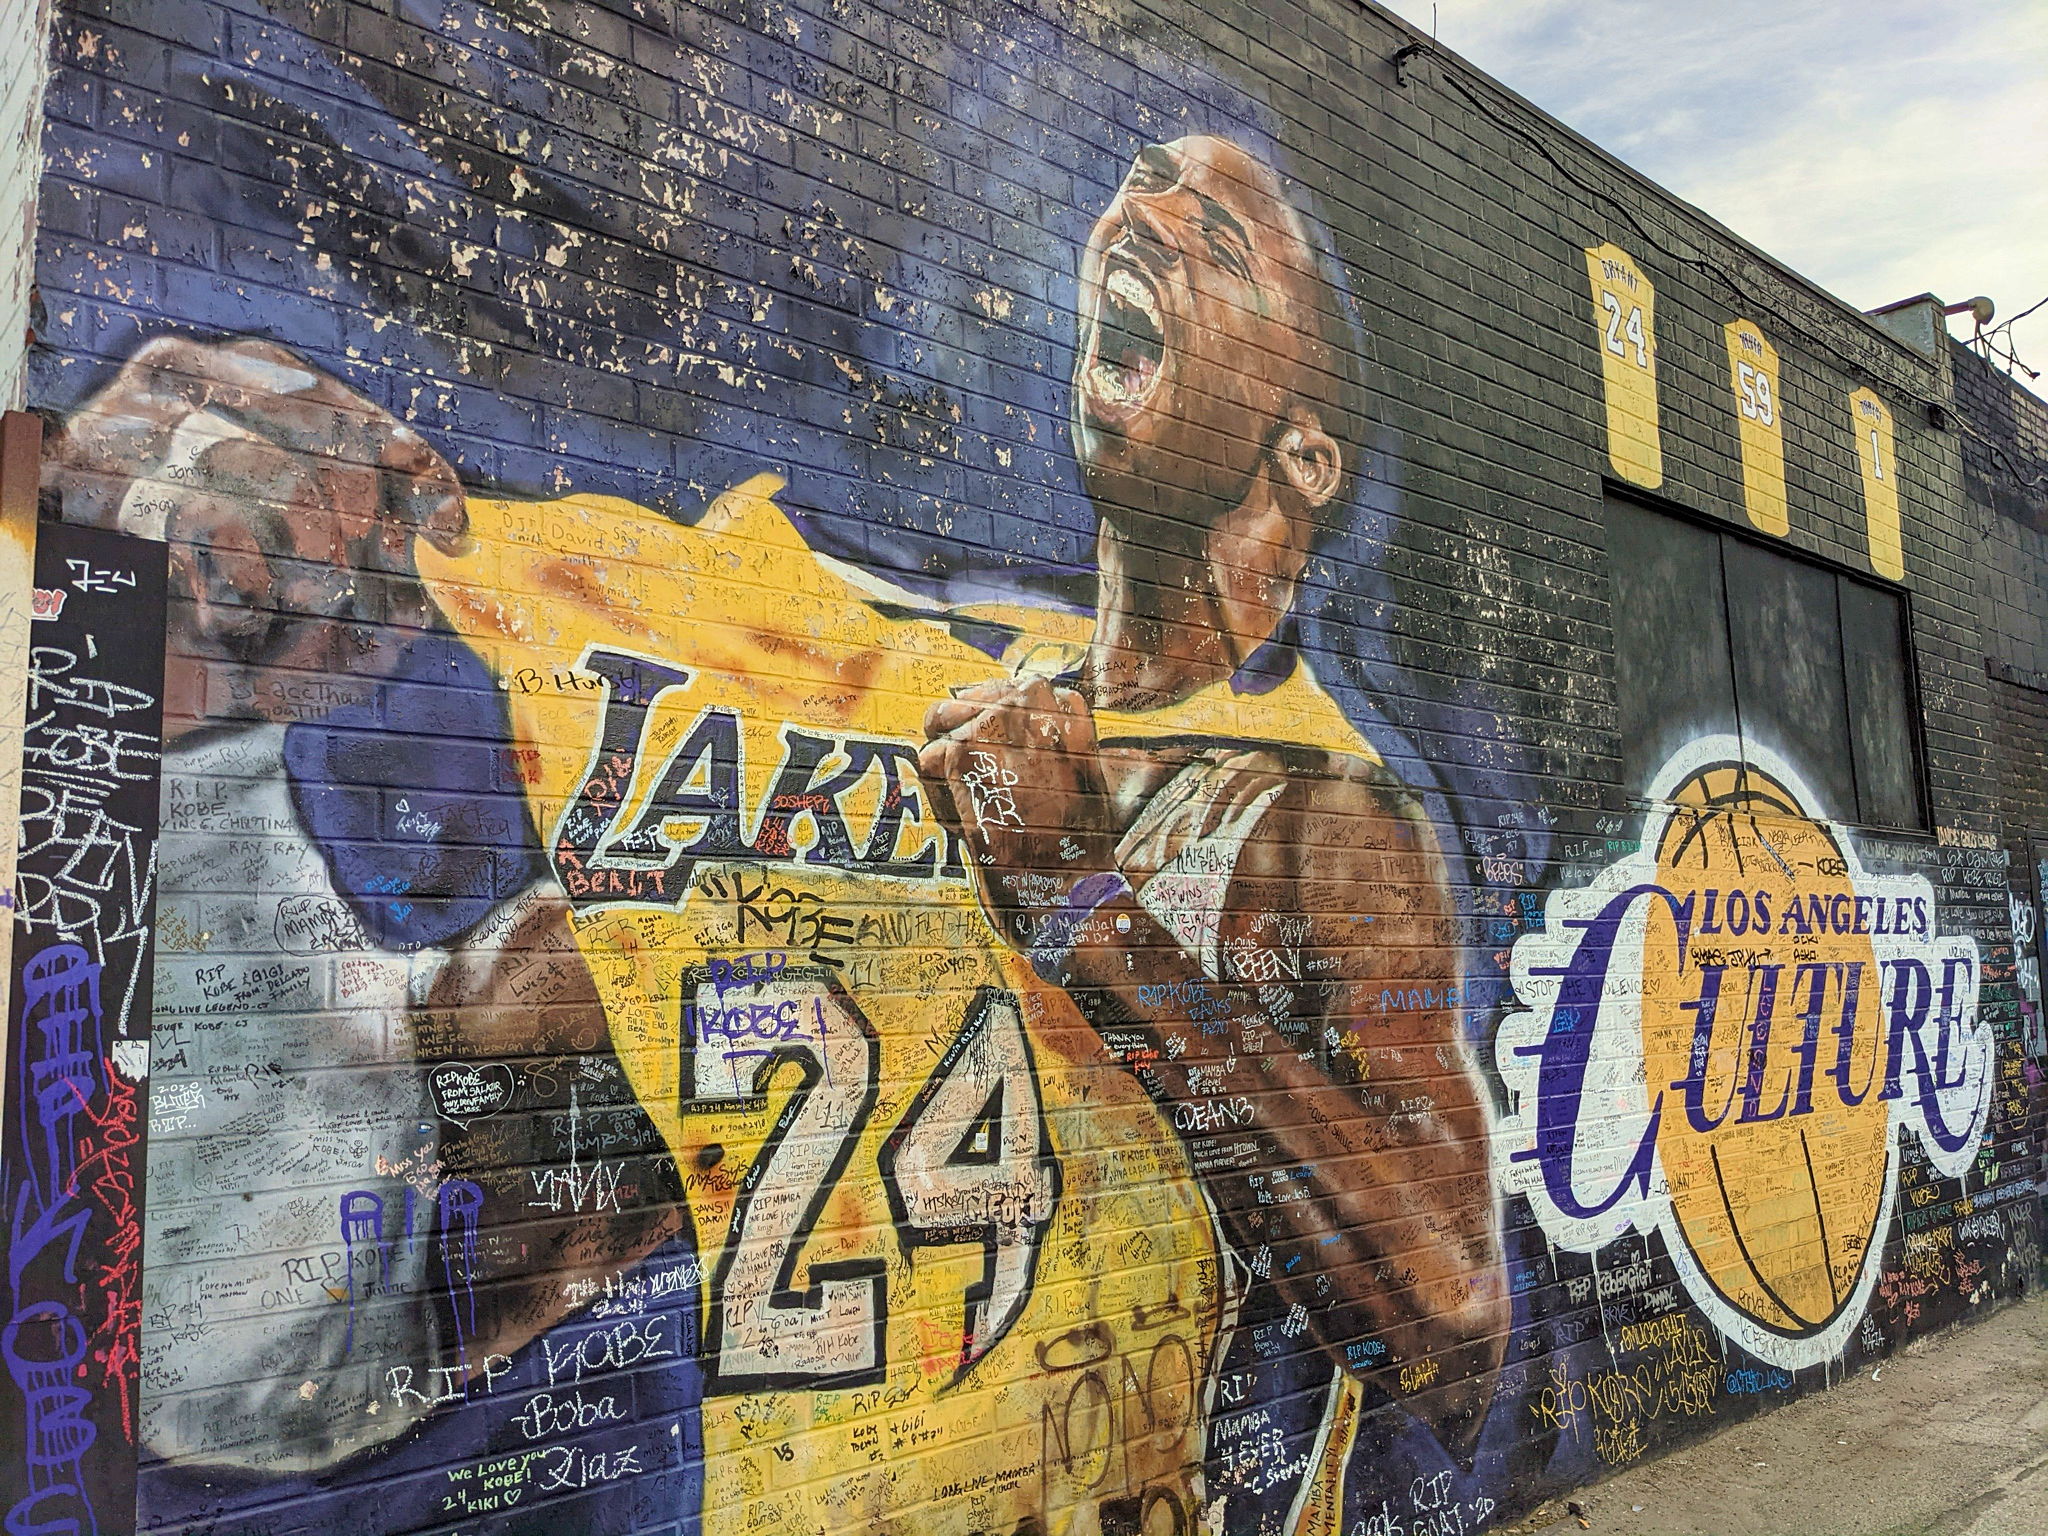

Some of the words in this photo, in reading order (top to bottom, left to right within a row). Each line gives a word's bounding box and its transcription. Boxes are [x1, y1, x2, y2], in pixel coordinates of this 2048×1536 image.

[1600, 258, 1638, 293] BRYANT
[1603, 290, 1648, 369] 24
[1737, 360, 1774, 427] 59
[1870, 430, 1884, 480] 1
[1700, 888, 1772, 937] LOS
[1779, 892, 1928, 937] ANGELES
[195, 964, 227, 986] RIP
[203, 978, 238, 1000] KOBE
[177, 1003, 201, 1013] LIVE
[1511, 884, 1985, 1219] CULTURE
[682, 962, 1063, 1392] 24
[282, 1251, 342, 1287] RIP
[1408, 1470, 1455, 1514] RIP
